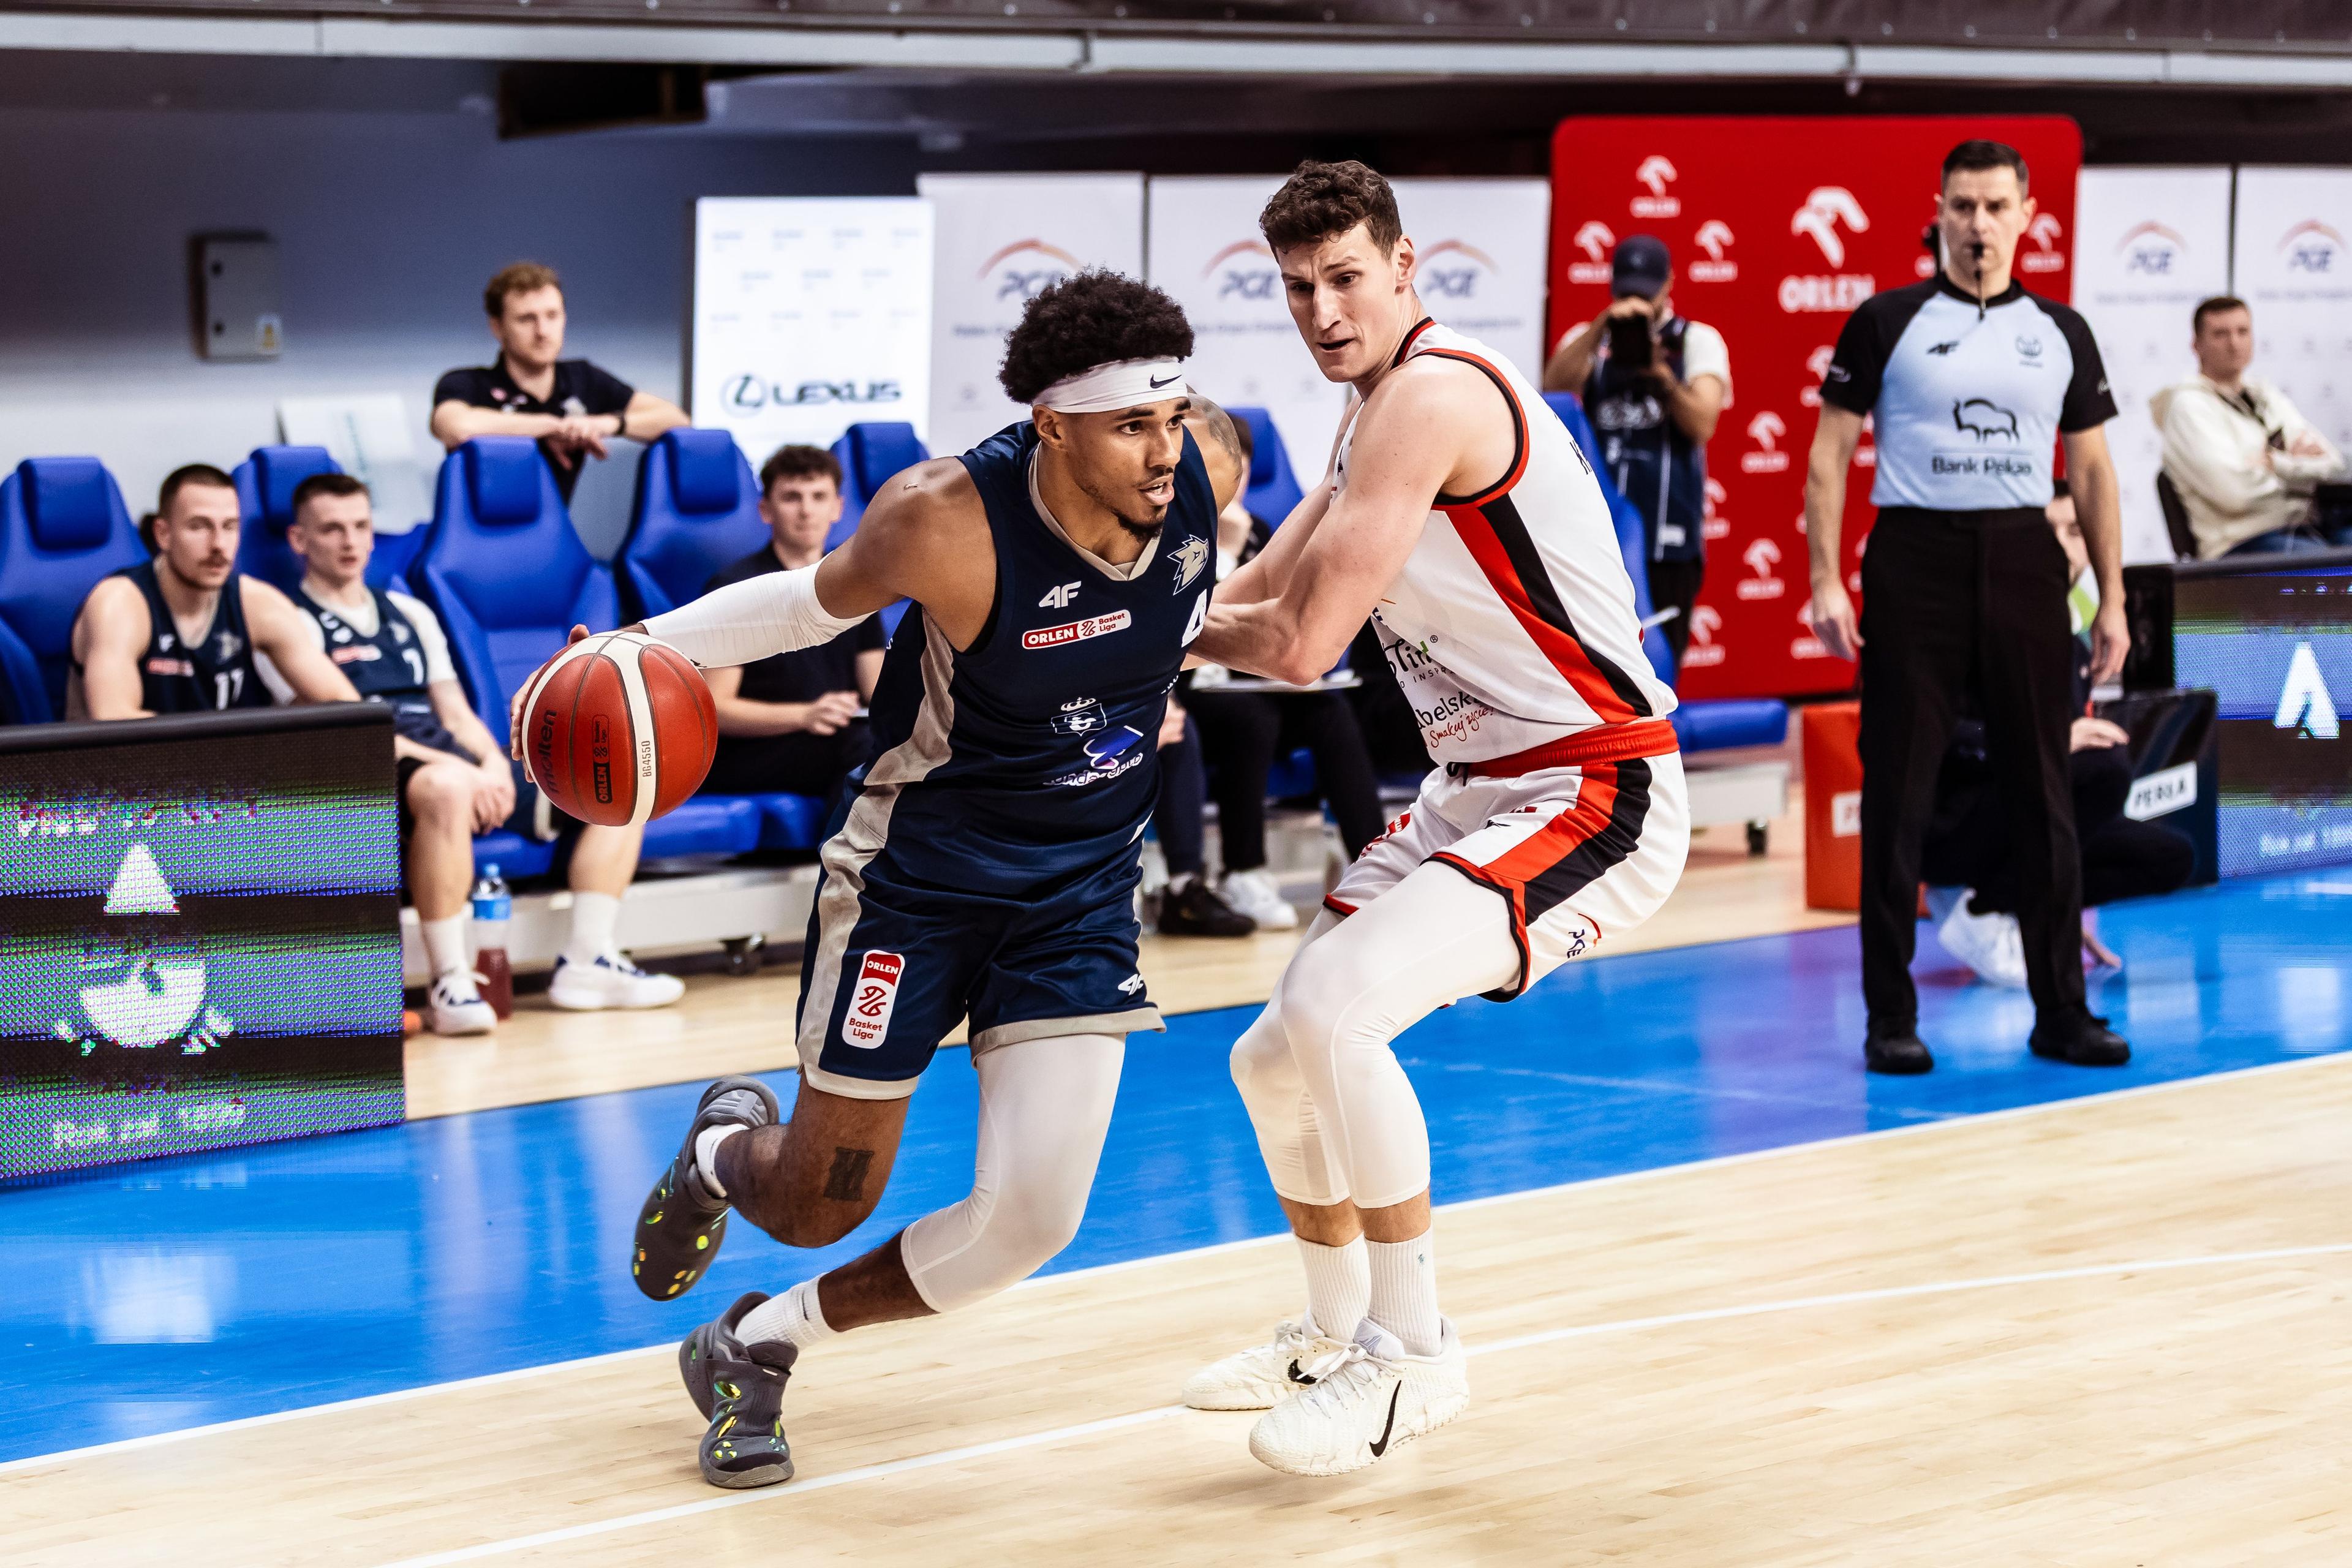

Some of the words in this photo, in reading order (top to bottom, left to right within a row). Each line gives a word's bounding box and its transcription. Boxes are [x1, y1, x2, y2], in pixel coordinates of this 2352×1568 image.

[772, 379, 901, 405] LEXUS
[1932, 457, 1977, 474] Bank
[1039, 581, 1081, 608] 4F
[1028, 627, 1074, 644] ORLEN
[1099, 613, 1125, 625] Basket
[641, 740, 652, 777] BG4550
[597, 766, 608, 802] ORLEN
[867, 960, 899, 974] ORLEN
[848, 1017, 883, 1031] Basket
[853, 1028, 874, 1039] Liga
